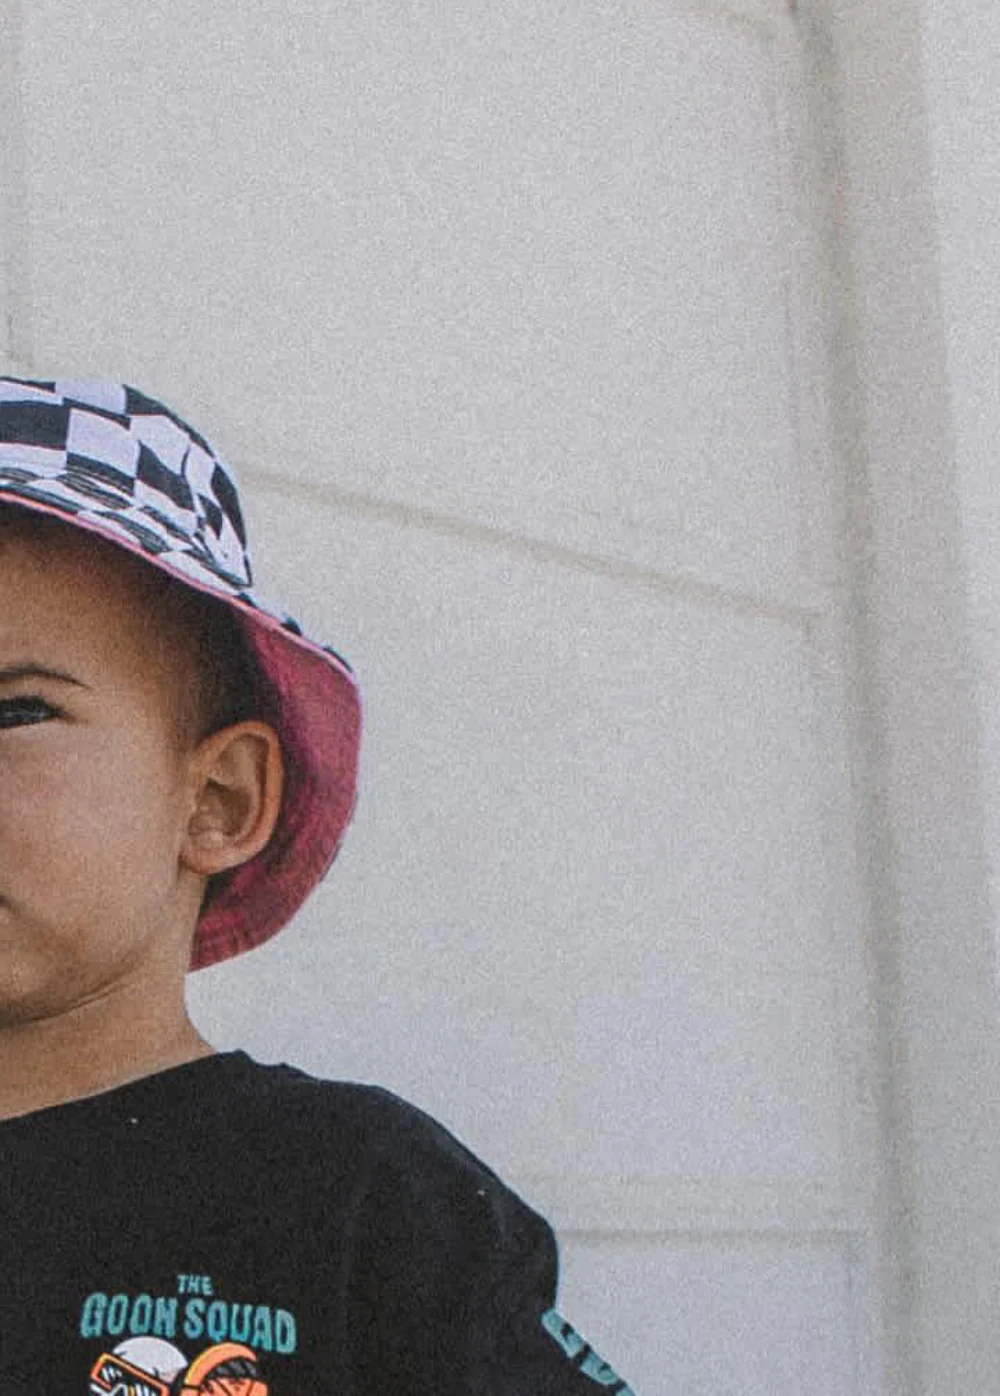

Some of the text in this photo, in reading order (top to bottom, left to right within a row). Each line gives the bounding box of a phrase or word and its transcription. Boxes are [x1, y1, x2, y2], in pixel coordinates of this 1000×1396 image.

[178, 1275, 213, 1294] THE
[79, 1292, 298, 1354] GOON SQUAD
